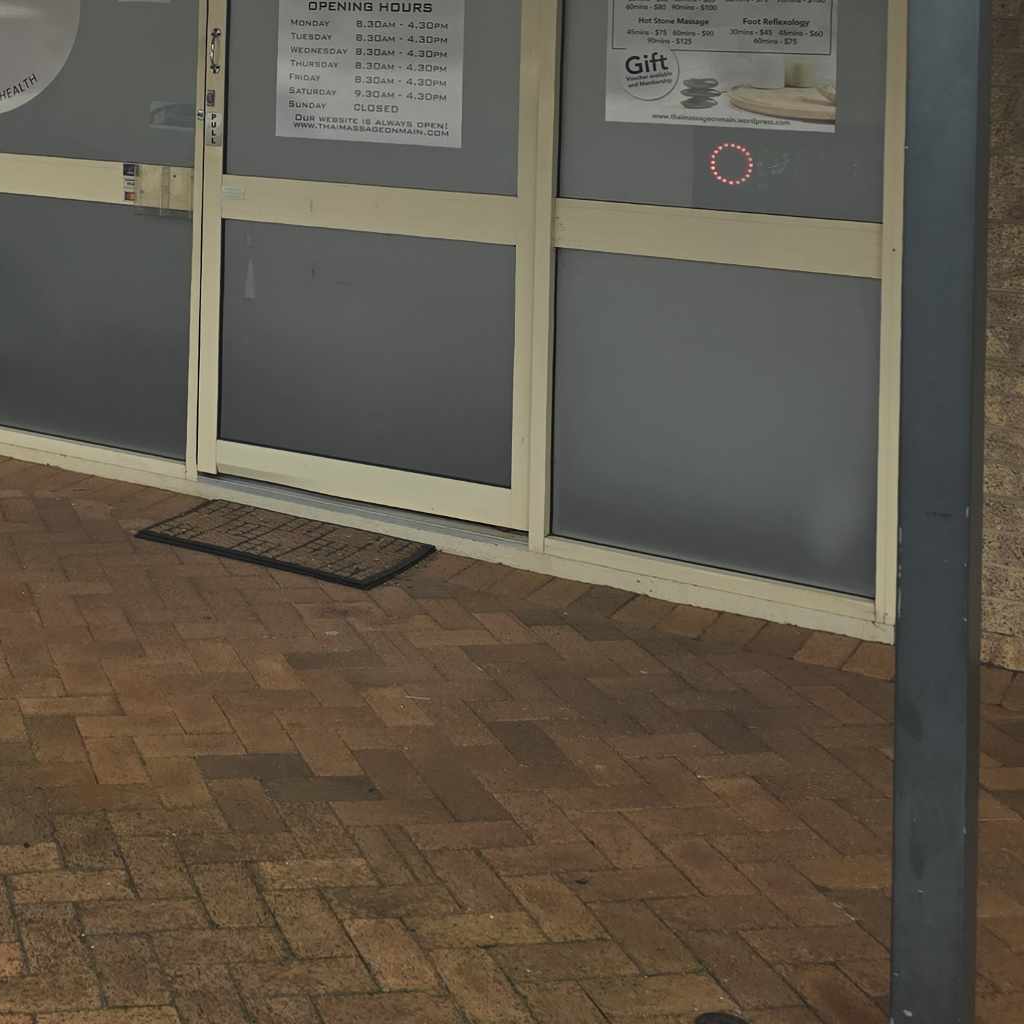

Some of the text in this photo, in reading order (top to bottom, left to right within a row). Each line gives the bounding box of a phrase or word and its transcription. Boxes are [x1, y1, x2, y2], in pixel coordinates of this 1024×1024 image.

[308, 0, 433, 14] OPENING HOURS
[638, 16, 710, 27] Hot Stone Massage
[742, 17, 811, 28] Foot Reflexology
[625, 51, 669, 75] Gift
[288, 99, 400, 113] SUNDAY CLOSED
[295, 113, 316, 122] OUR
[319, 115, 359, 125] WEBSITE
[375, 119, 413, 129] ALWAYS
[416, 121, 448, 131] OPEN!
